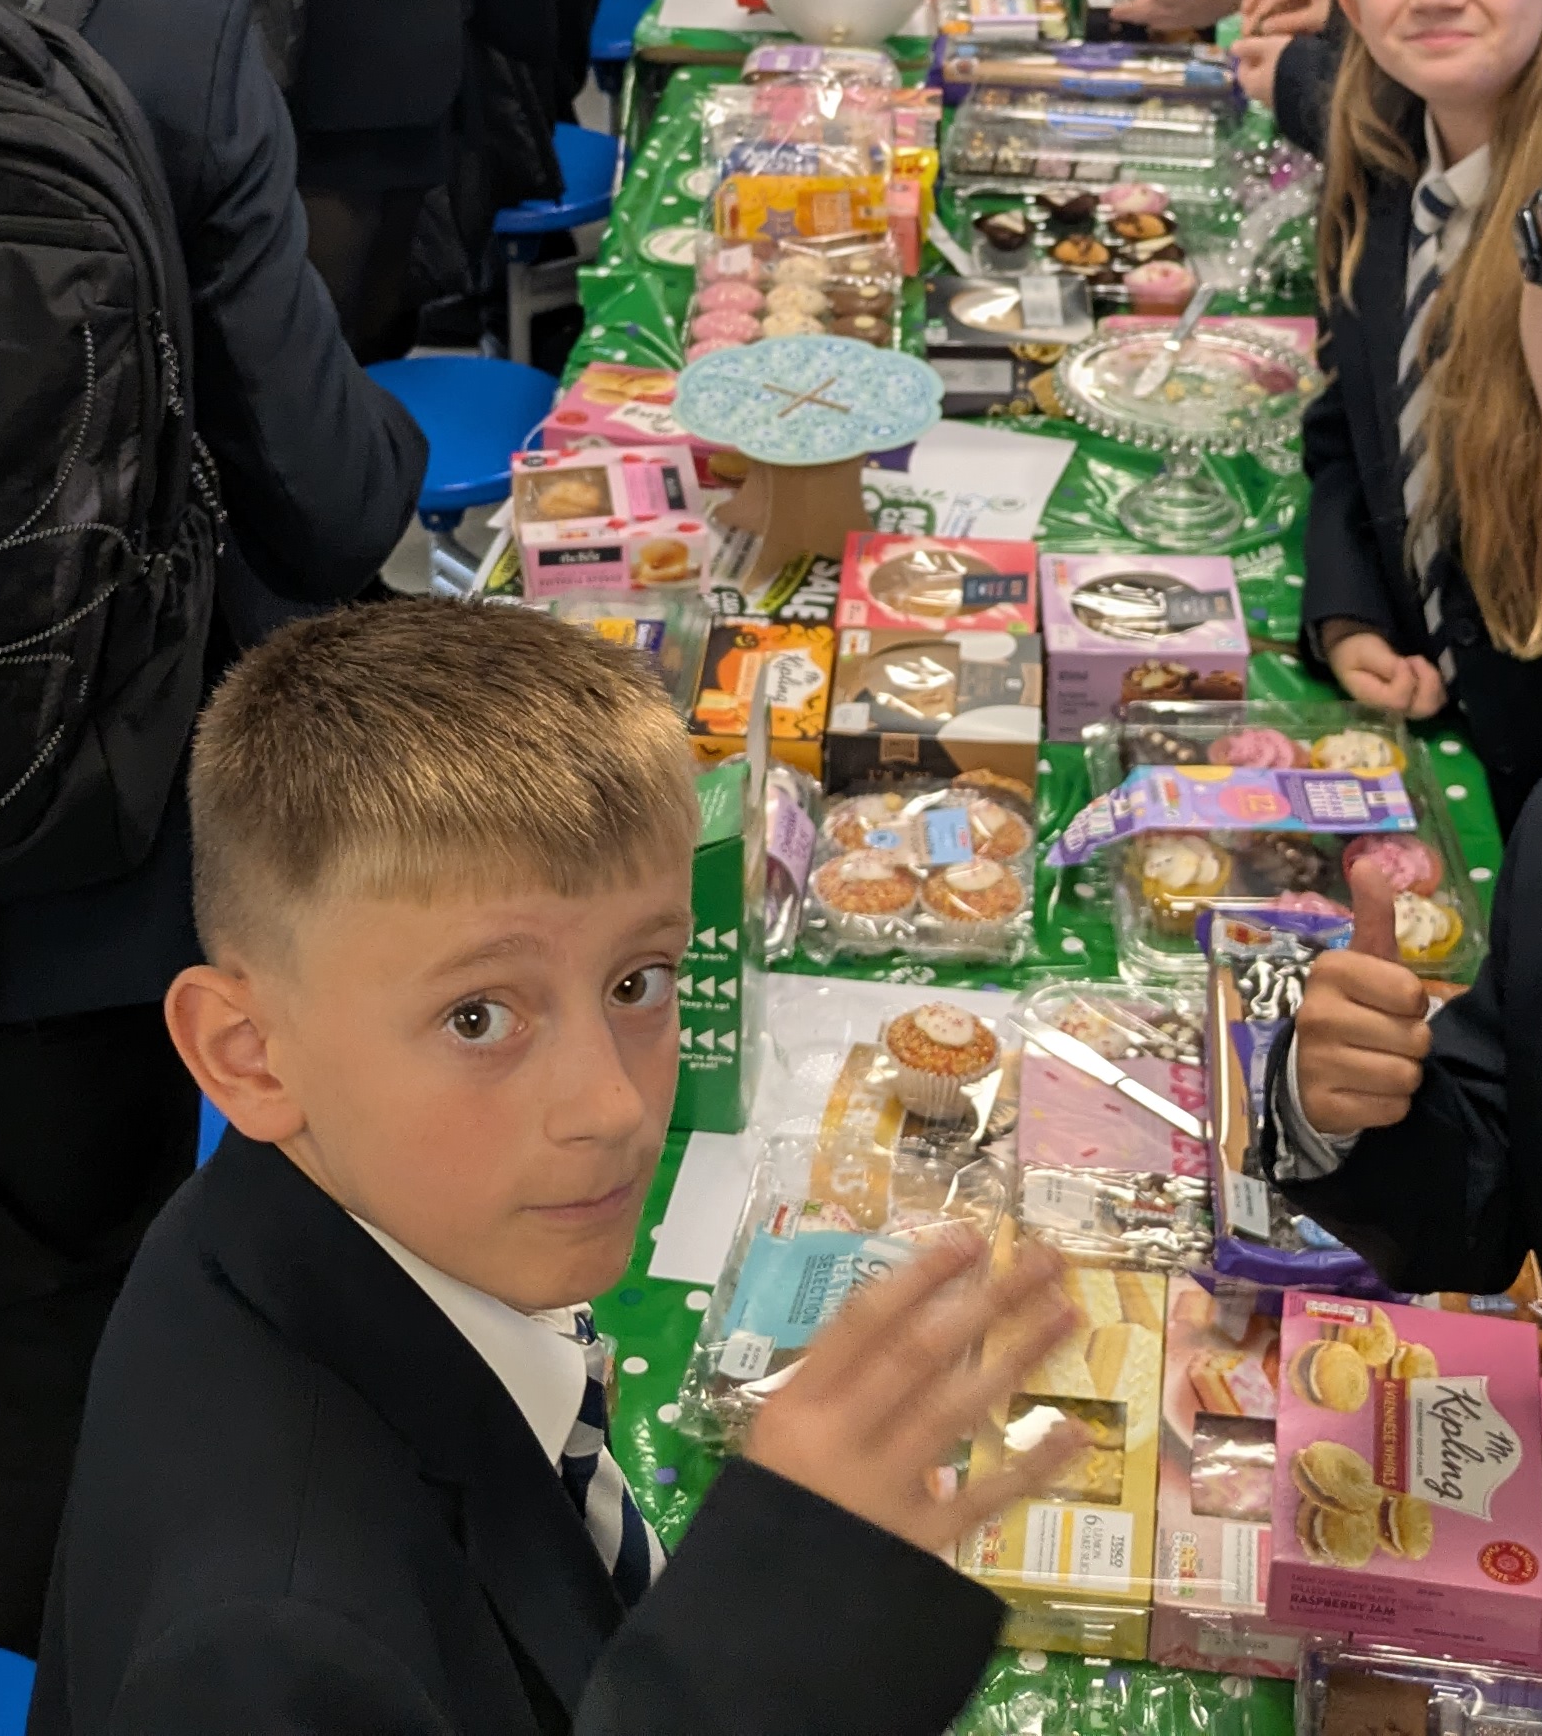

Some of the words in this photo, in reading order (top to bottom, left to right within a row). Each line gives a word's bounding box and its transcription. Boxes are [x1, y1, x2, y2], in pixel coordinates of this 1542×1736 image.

[780, 559, 842, 621] SALE
[766, 652, 807, 704] Kipling
[1170, 1064, 1208, 1176] CAES
[801, 1253, 835, 1325] SELECTION
[1425, 1384, 1483, 1502] Kipling
[1484, 1430, 1518, 1467] Mr
[1082, 1514, 1104, 1527] 6
[1116, 1534, 1125, 1568] TESCO
[1290, 1593, 1366, 1612] RASPBERRY
[1368, 1604, 1396, 1616] JAM
